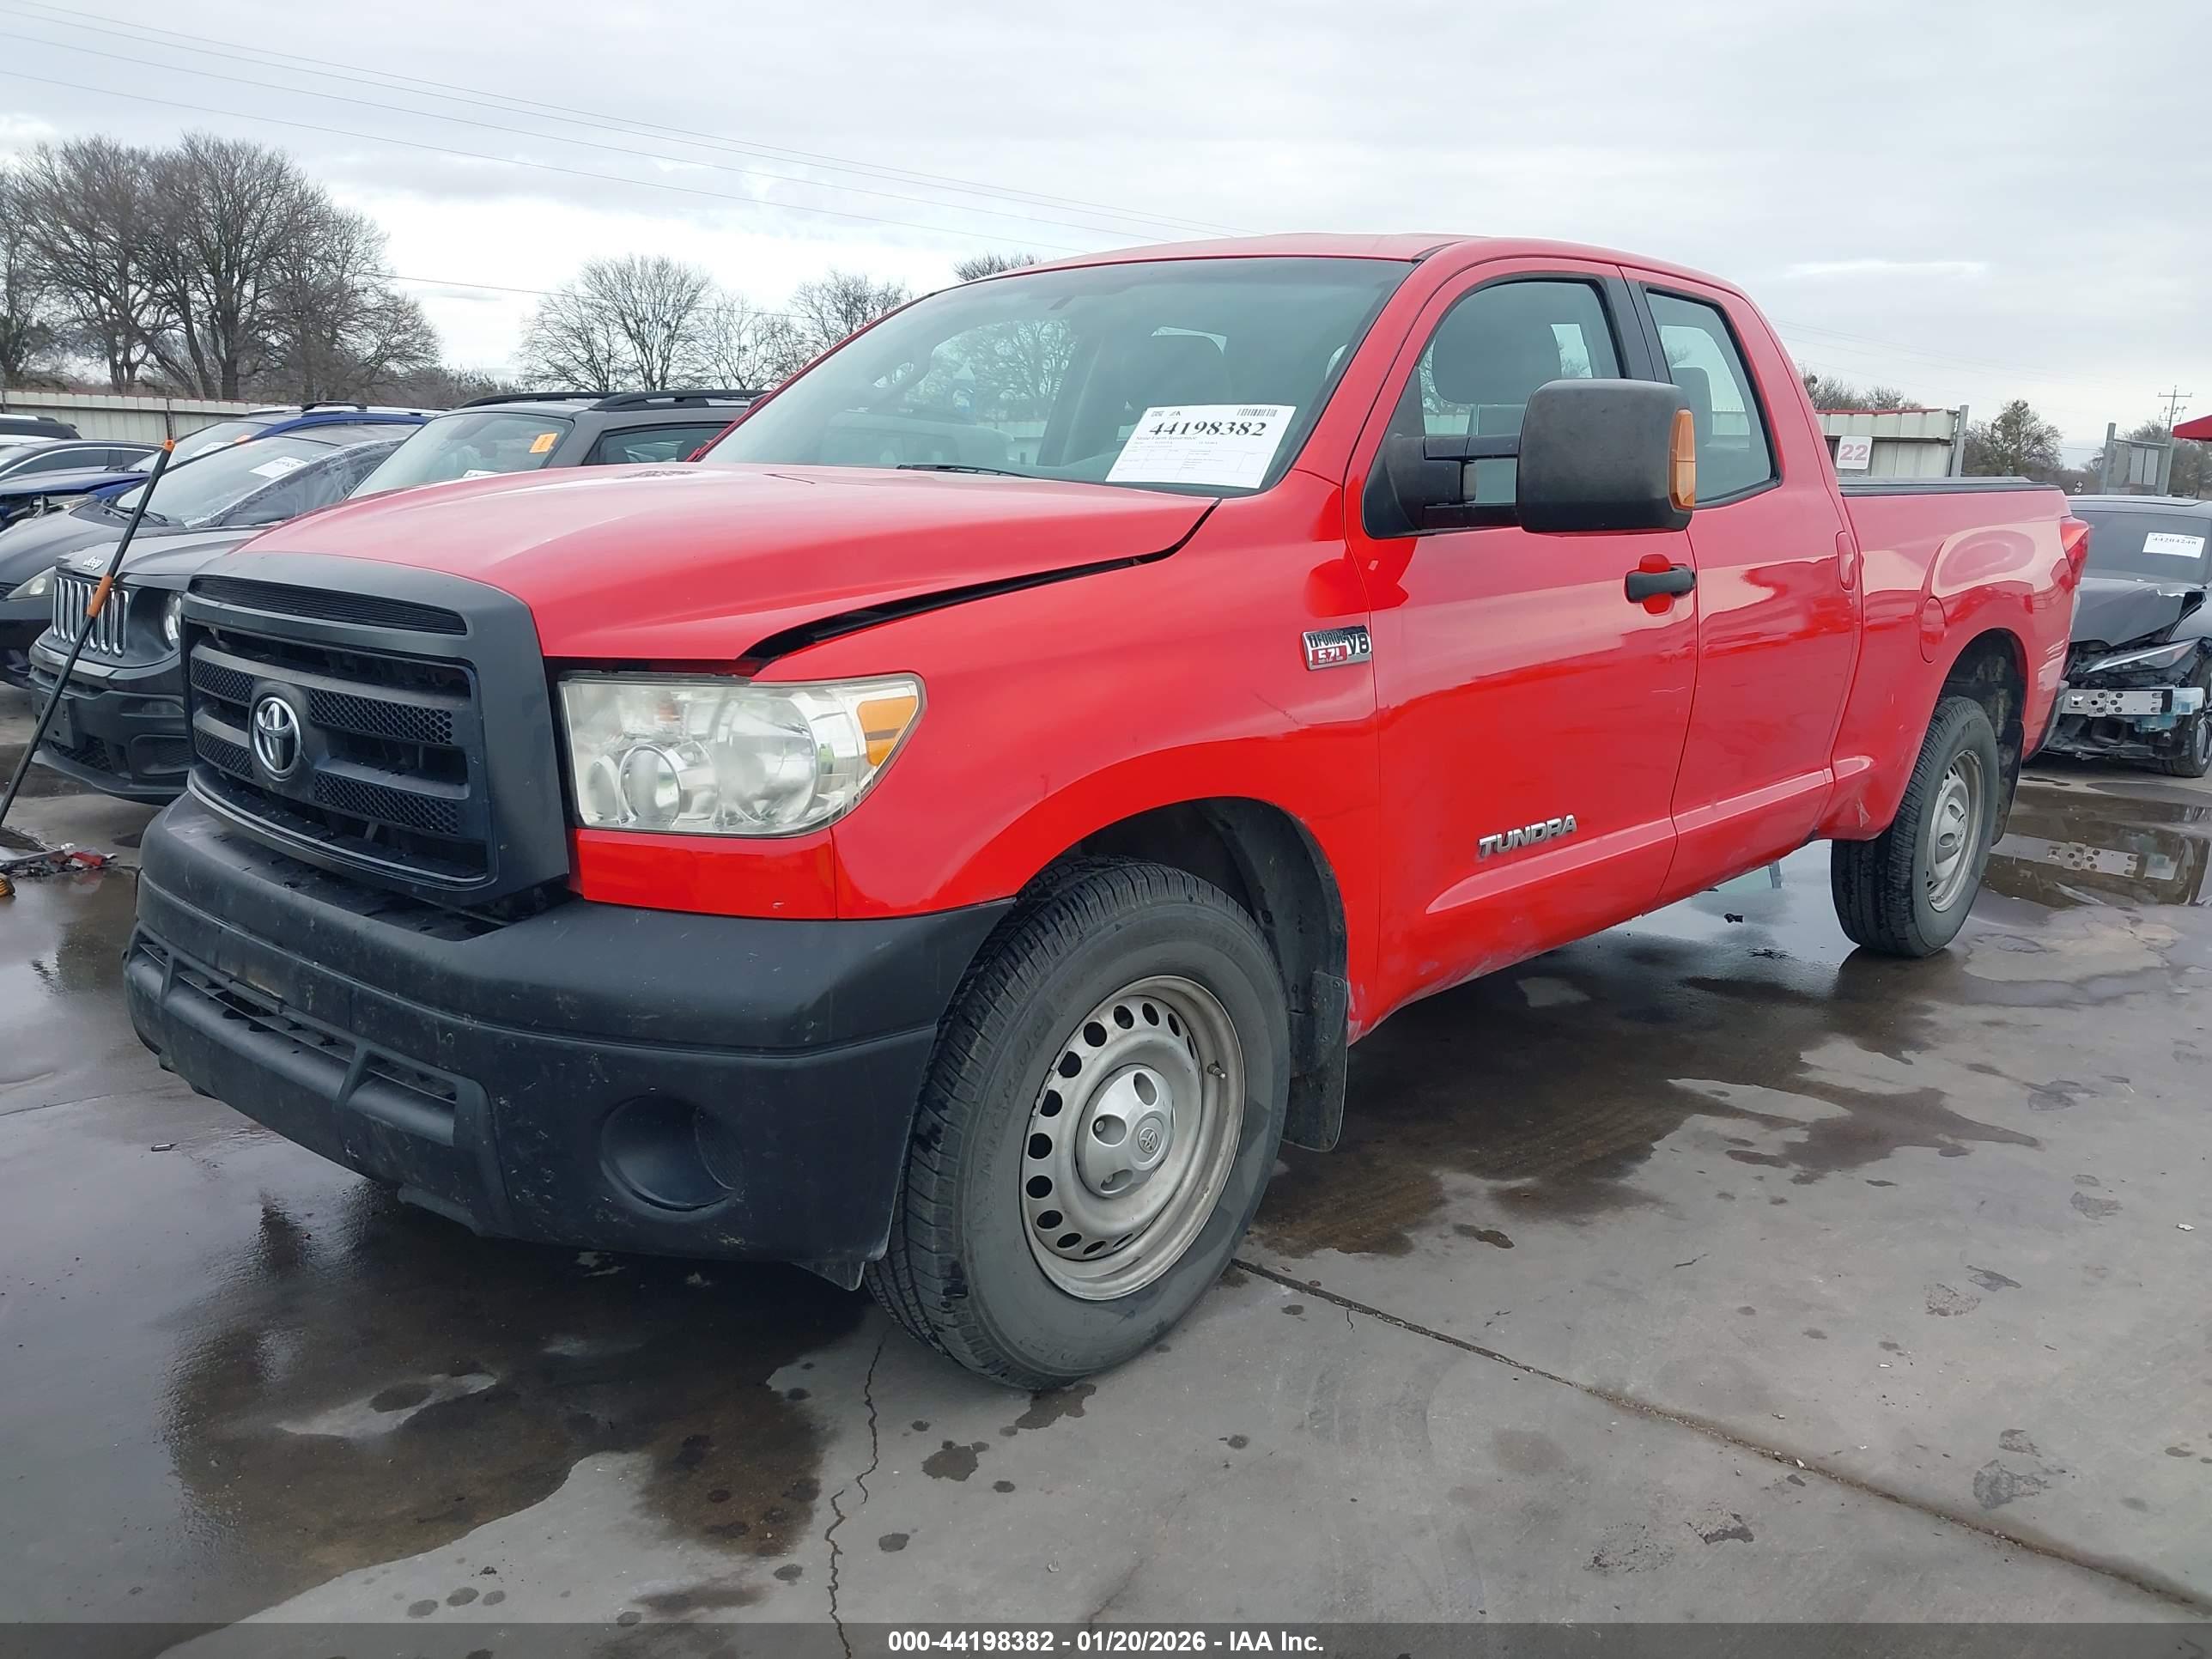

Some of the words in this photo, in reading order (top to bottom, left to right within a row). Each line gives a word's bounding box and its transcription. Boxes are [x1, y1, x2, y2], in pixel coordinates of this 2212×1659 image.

[1149, 421, 1267, 437] 44198382
[1839, 443, 1869, 461] 22
[1346, 633, 1370, 655] V8
[1478, 814, 1577, 858] TUNDRA
